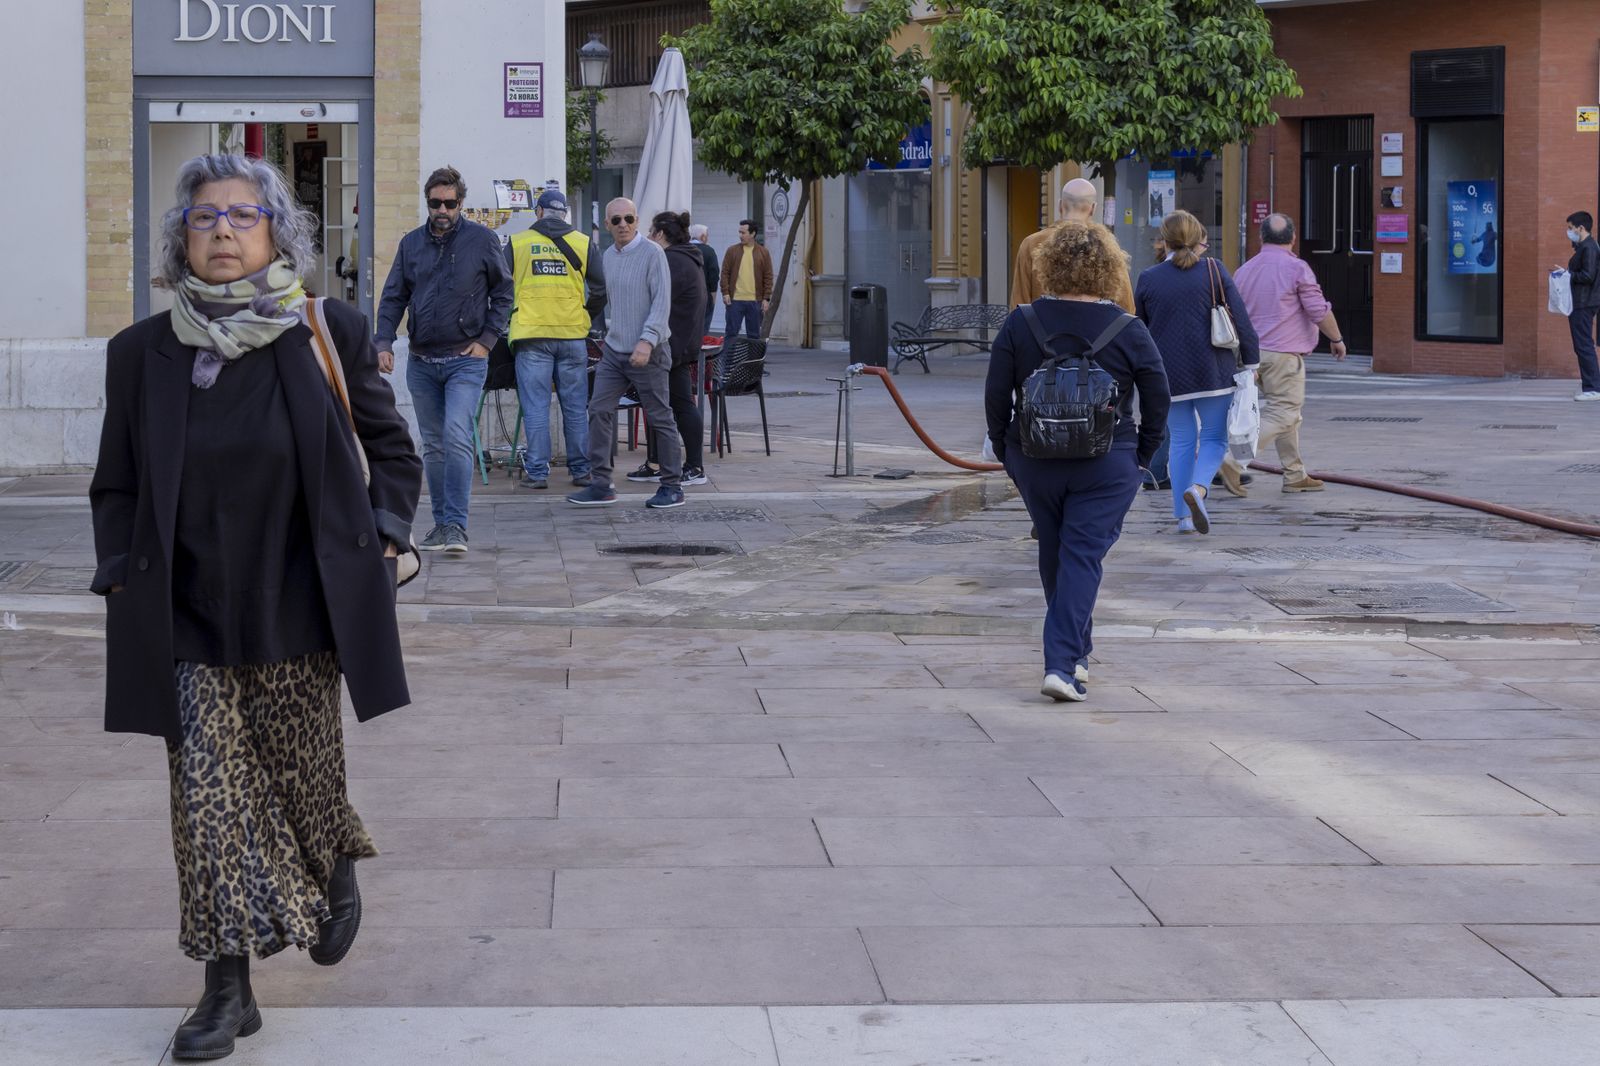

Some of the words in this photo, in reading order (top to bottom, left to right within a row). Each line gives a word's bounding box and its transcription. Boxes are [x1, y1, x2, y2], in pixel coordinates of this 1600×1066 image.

[174, 0, 336, 42] DIONI
[509, 93, 517, 101] 24
[518, 93, 539, 101] HORAS
[1482, 203, 1493, 214] 5G
[542, 246, 562, 254] ONC
[542, 266, 567, 274] ONCE
